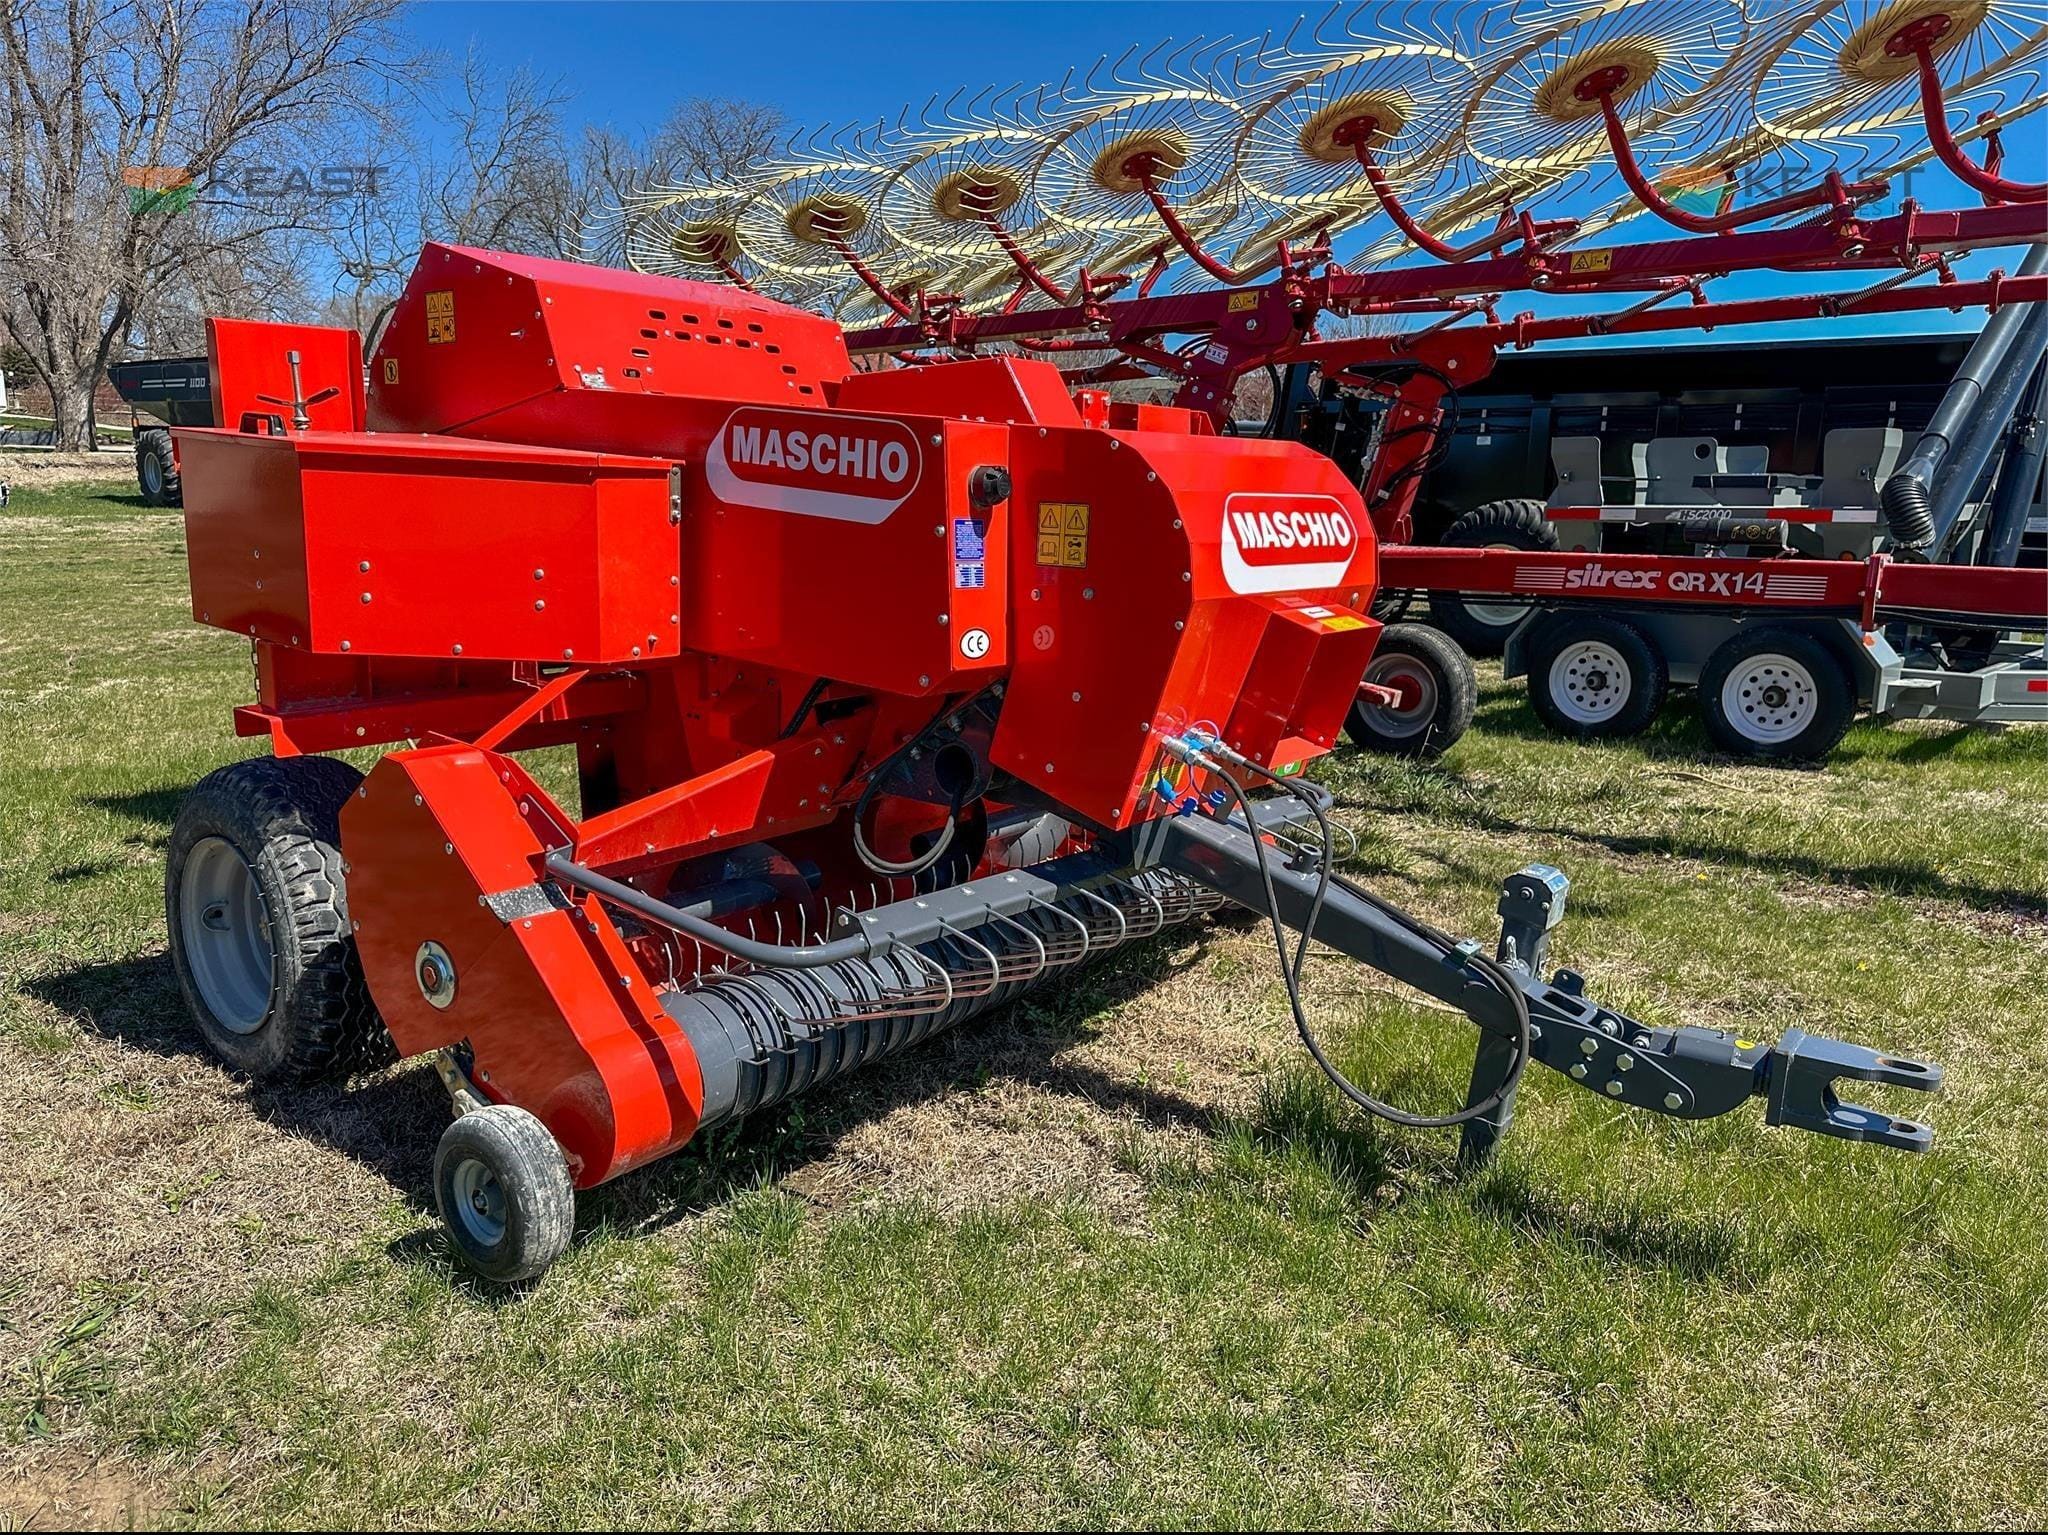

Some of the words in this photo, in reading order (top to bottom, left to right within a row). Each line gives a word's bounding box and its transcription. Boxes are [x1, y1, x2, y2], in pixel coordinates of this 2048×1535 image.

[189, 377, 206, 388] 1100
[732, 425, 909, 483] MASCHIO
[1231, 511, 1351, 549] MASCHIO
[1565, 563, 1661, 589] sitrex
[967, 635, 984, 653] CE
